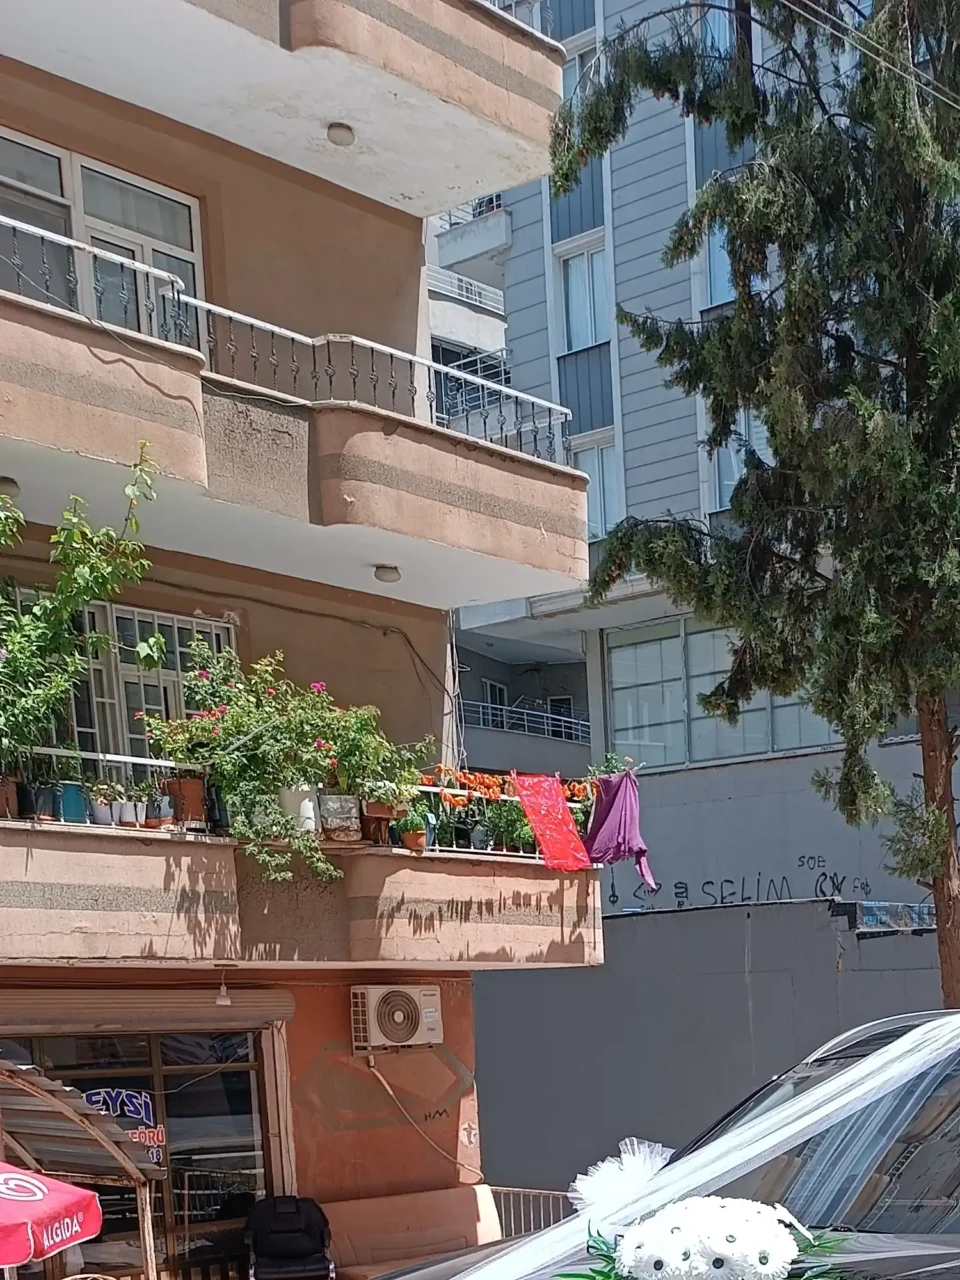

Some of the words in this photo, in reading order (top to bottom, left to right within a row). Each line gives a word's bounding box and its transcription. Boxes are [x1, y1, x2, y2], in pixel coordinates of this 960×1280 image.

[701, 871, 794, 905] SELİM
[82, 1088, 154, 1127] EYSİ
[128, 1125, 165, 1146] FÖRÜ
[146, 1148, 162, 1163] 18
